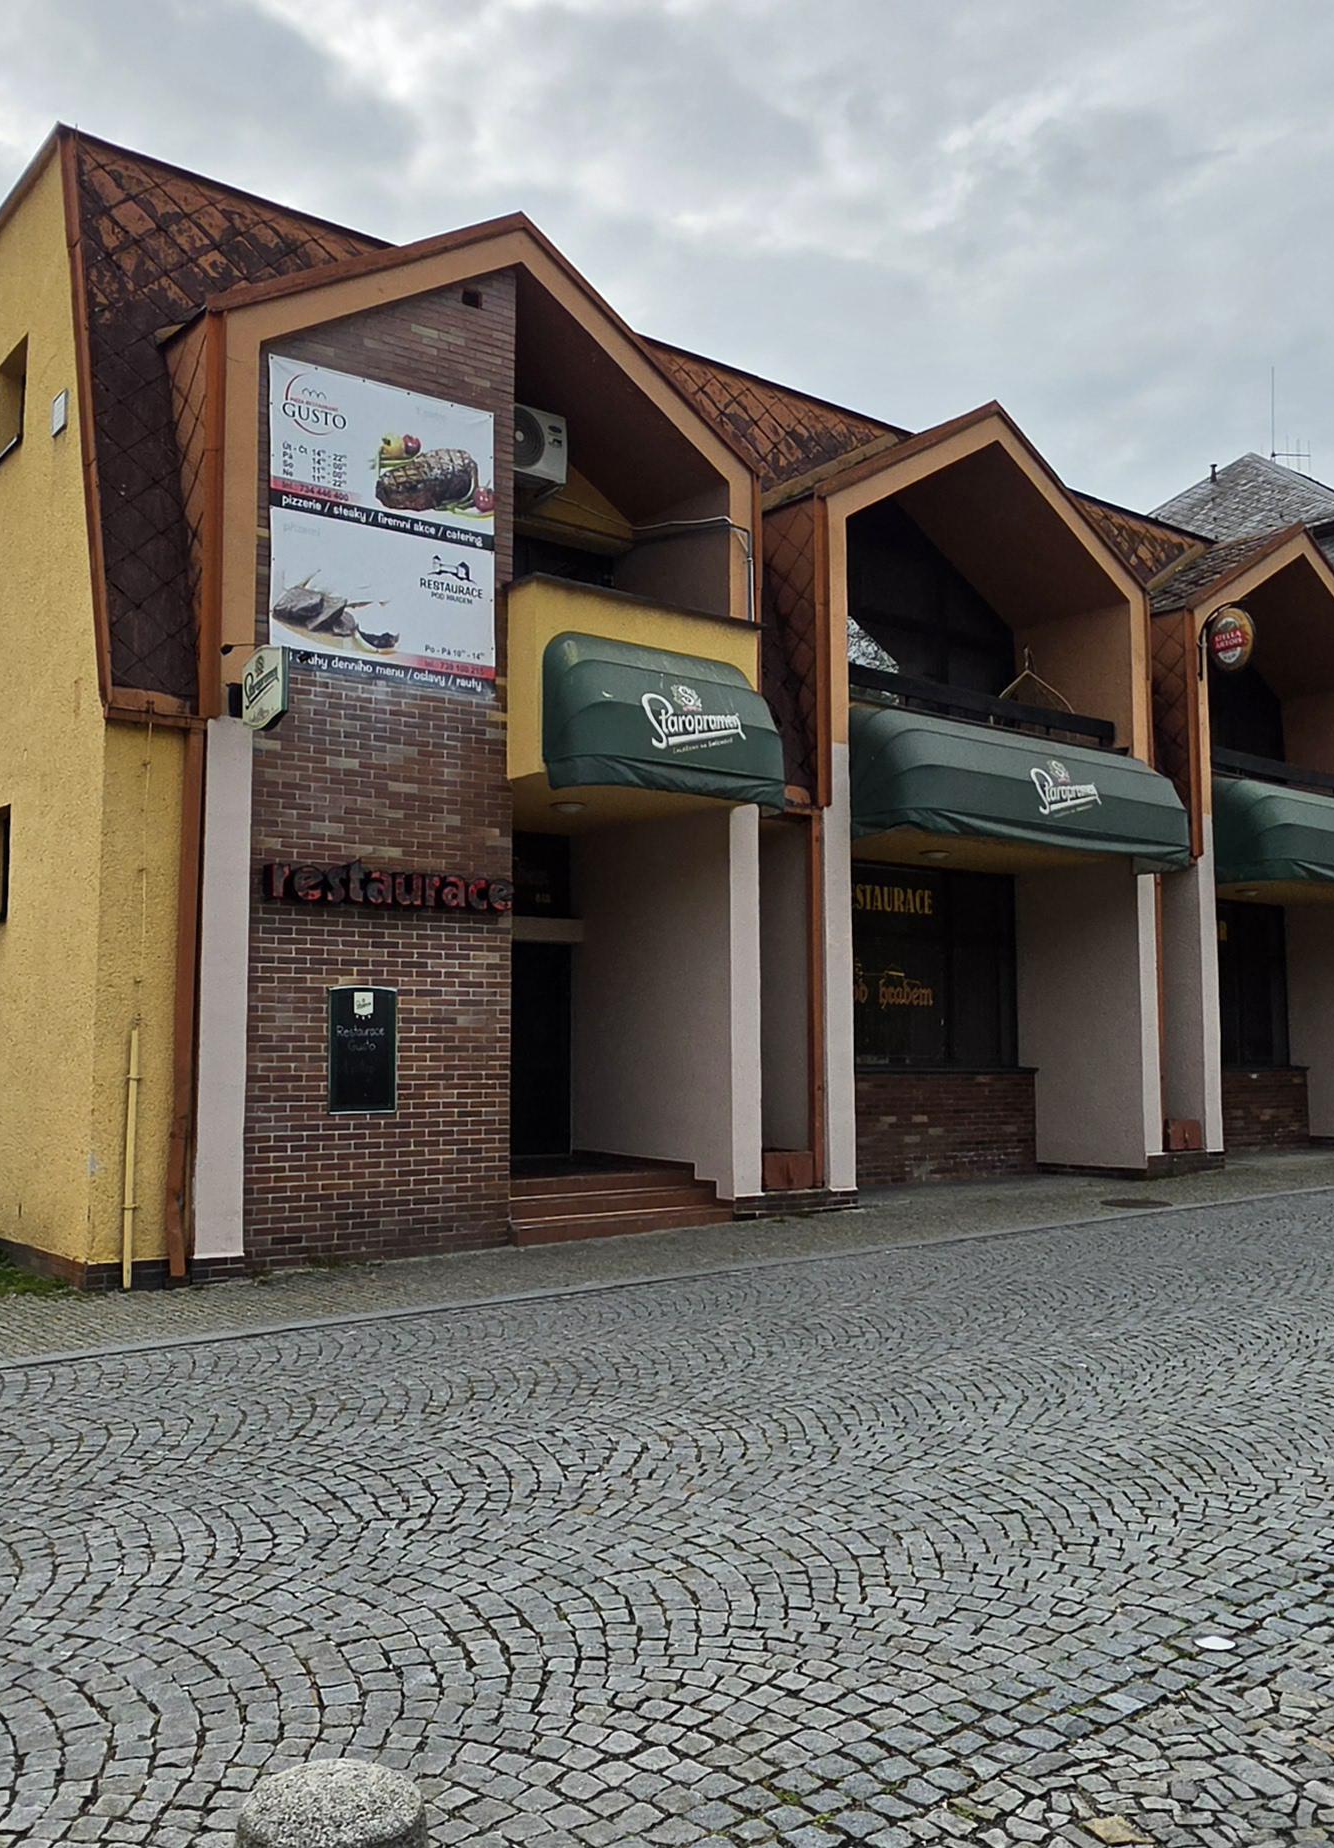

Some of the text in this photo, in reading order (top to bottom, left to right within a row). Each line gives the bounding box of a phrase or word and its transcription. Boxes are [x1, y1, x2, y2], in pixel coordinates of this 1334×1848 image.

[282, 402, 347, 430] GUSTO
[281, 494, 321, 511] pizzerie
[333, 504, 367, 523] steaky
[377, 510, 411, 530] firemní
[414, 521, 436, 536] akce
[446, 528, 484, 547] catering
[419, 578, 483, 599] RESTAURACE
[296, 651, 328, 670] uhy
[331, 655, 373, 674] denního
[376, 665, 404, 678] menu
[414, 669, 445, 688] oslavy
[456, 677, 483, 692] rauty
[642, 693, 746, 749] Staropramen
[269, 857, 515, 912] restaurace
[852, 884, 933, 914] STAURACE
